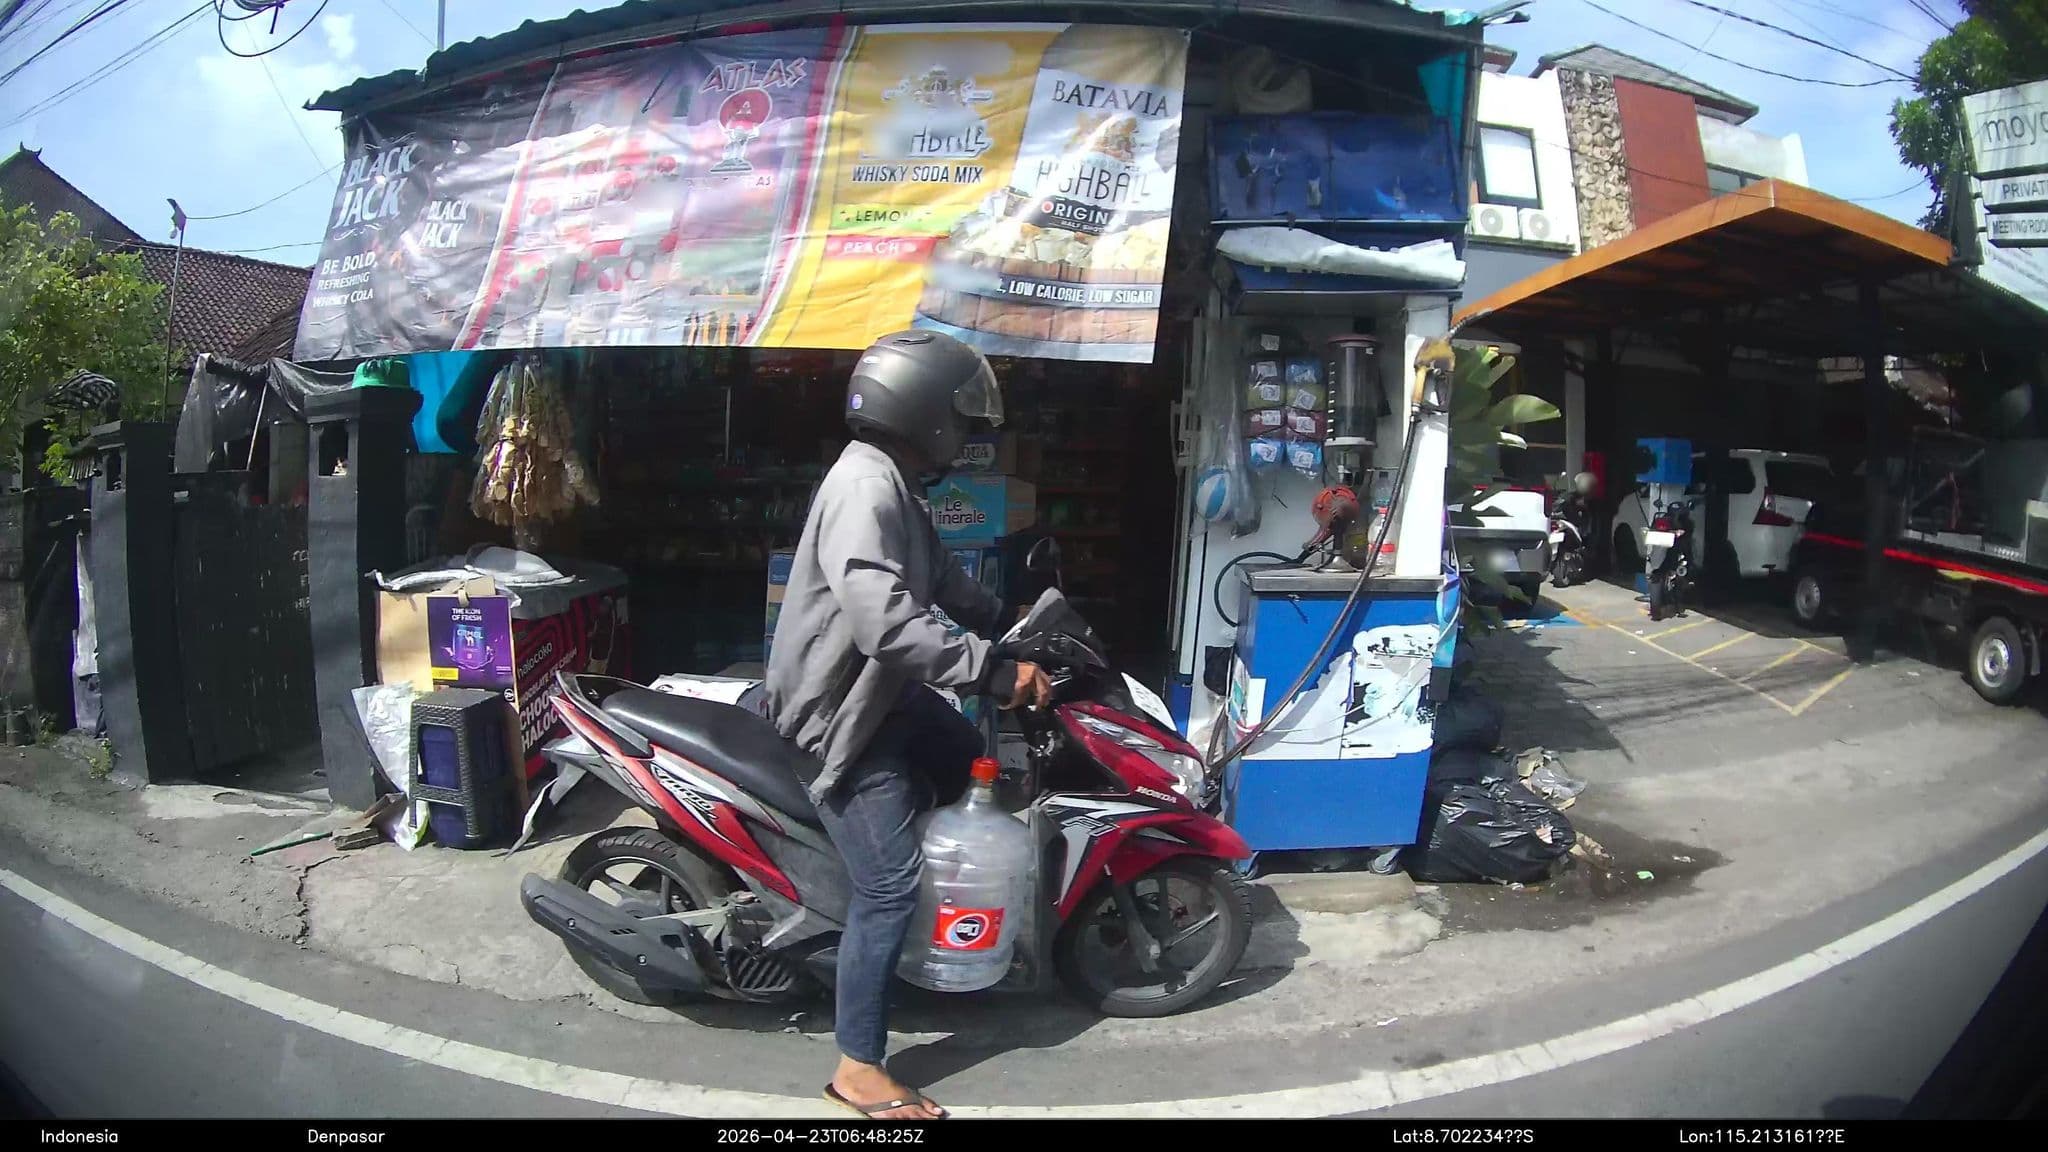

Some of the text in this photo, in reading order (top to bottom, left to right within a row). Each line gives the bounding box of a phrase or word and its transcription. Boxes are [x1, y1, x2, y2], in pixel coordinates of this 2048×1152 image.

[699, 57, 807, 94] ATLAS
[1051, 79, 1170, 117] BATAVIA
[344, 143, 418, 188] BLACK
[852, 165, 983, 183] WHISKY SODA MIX
[332, 176, 408, 229] JACK
[427, 200, 472, 220] BLACK
[418, 223, 464, 248] JACK
[1992, 219, 2027, 234] MEETING
[844, 241, 900, 255] PEACH
[321, 250, 378, 275] BE BOLD,
[316, 271, 370, 290] REFRESHING
[350, 288, 374, 303] COLA
[1009, 280, 1036, 297] LOW
[1036, 283, 1087, 304] CALORIE,
[1088, 289, 1115, 302] LOW
[1115, 289, 1154, 304] SUGAR
[945, 496, 961, 512] Le
[1134, 786, 1177, 803] HONDA
